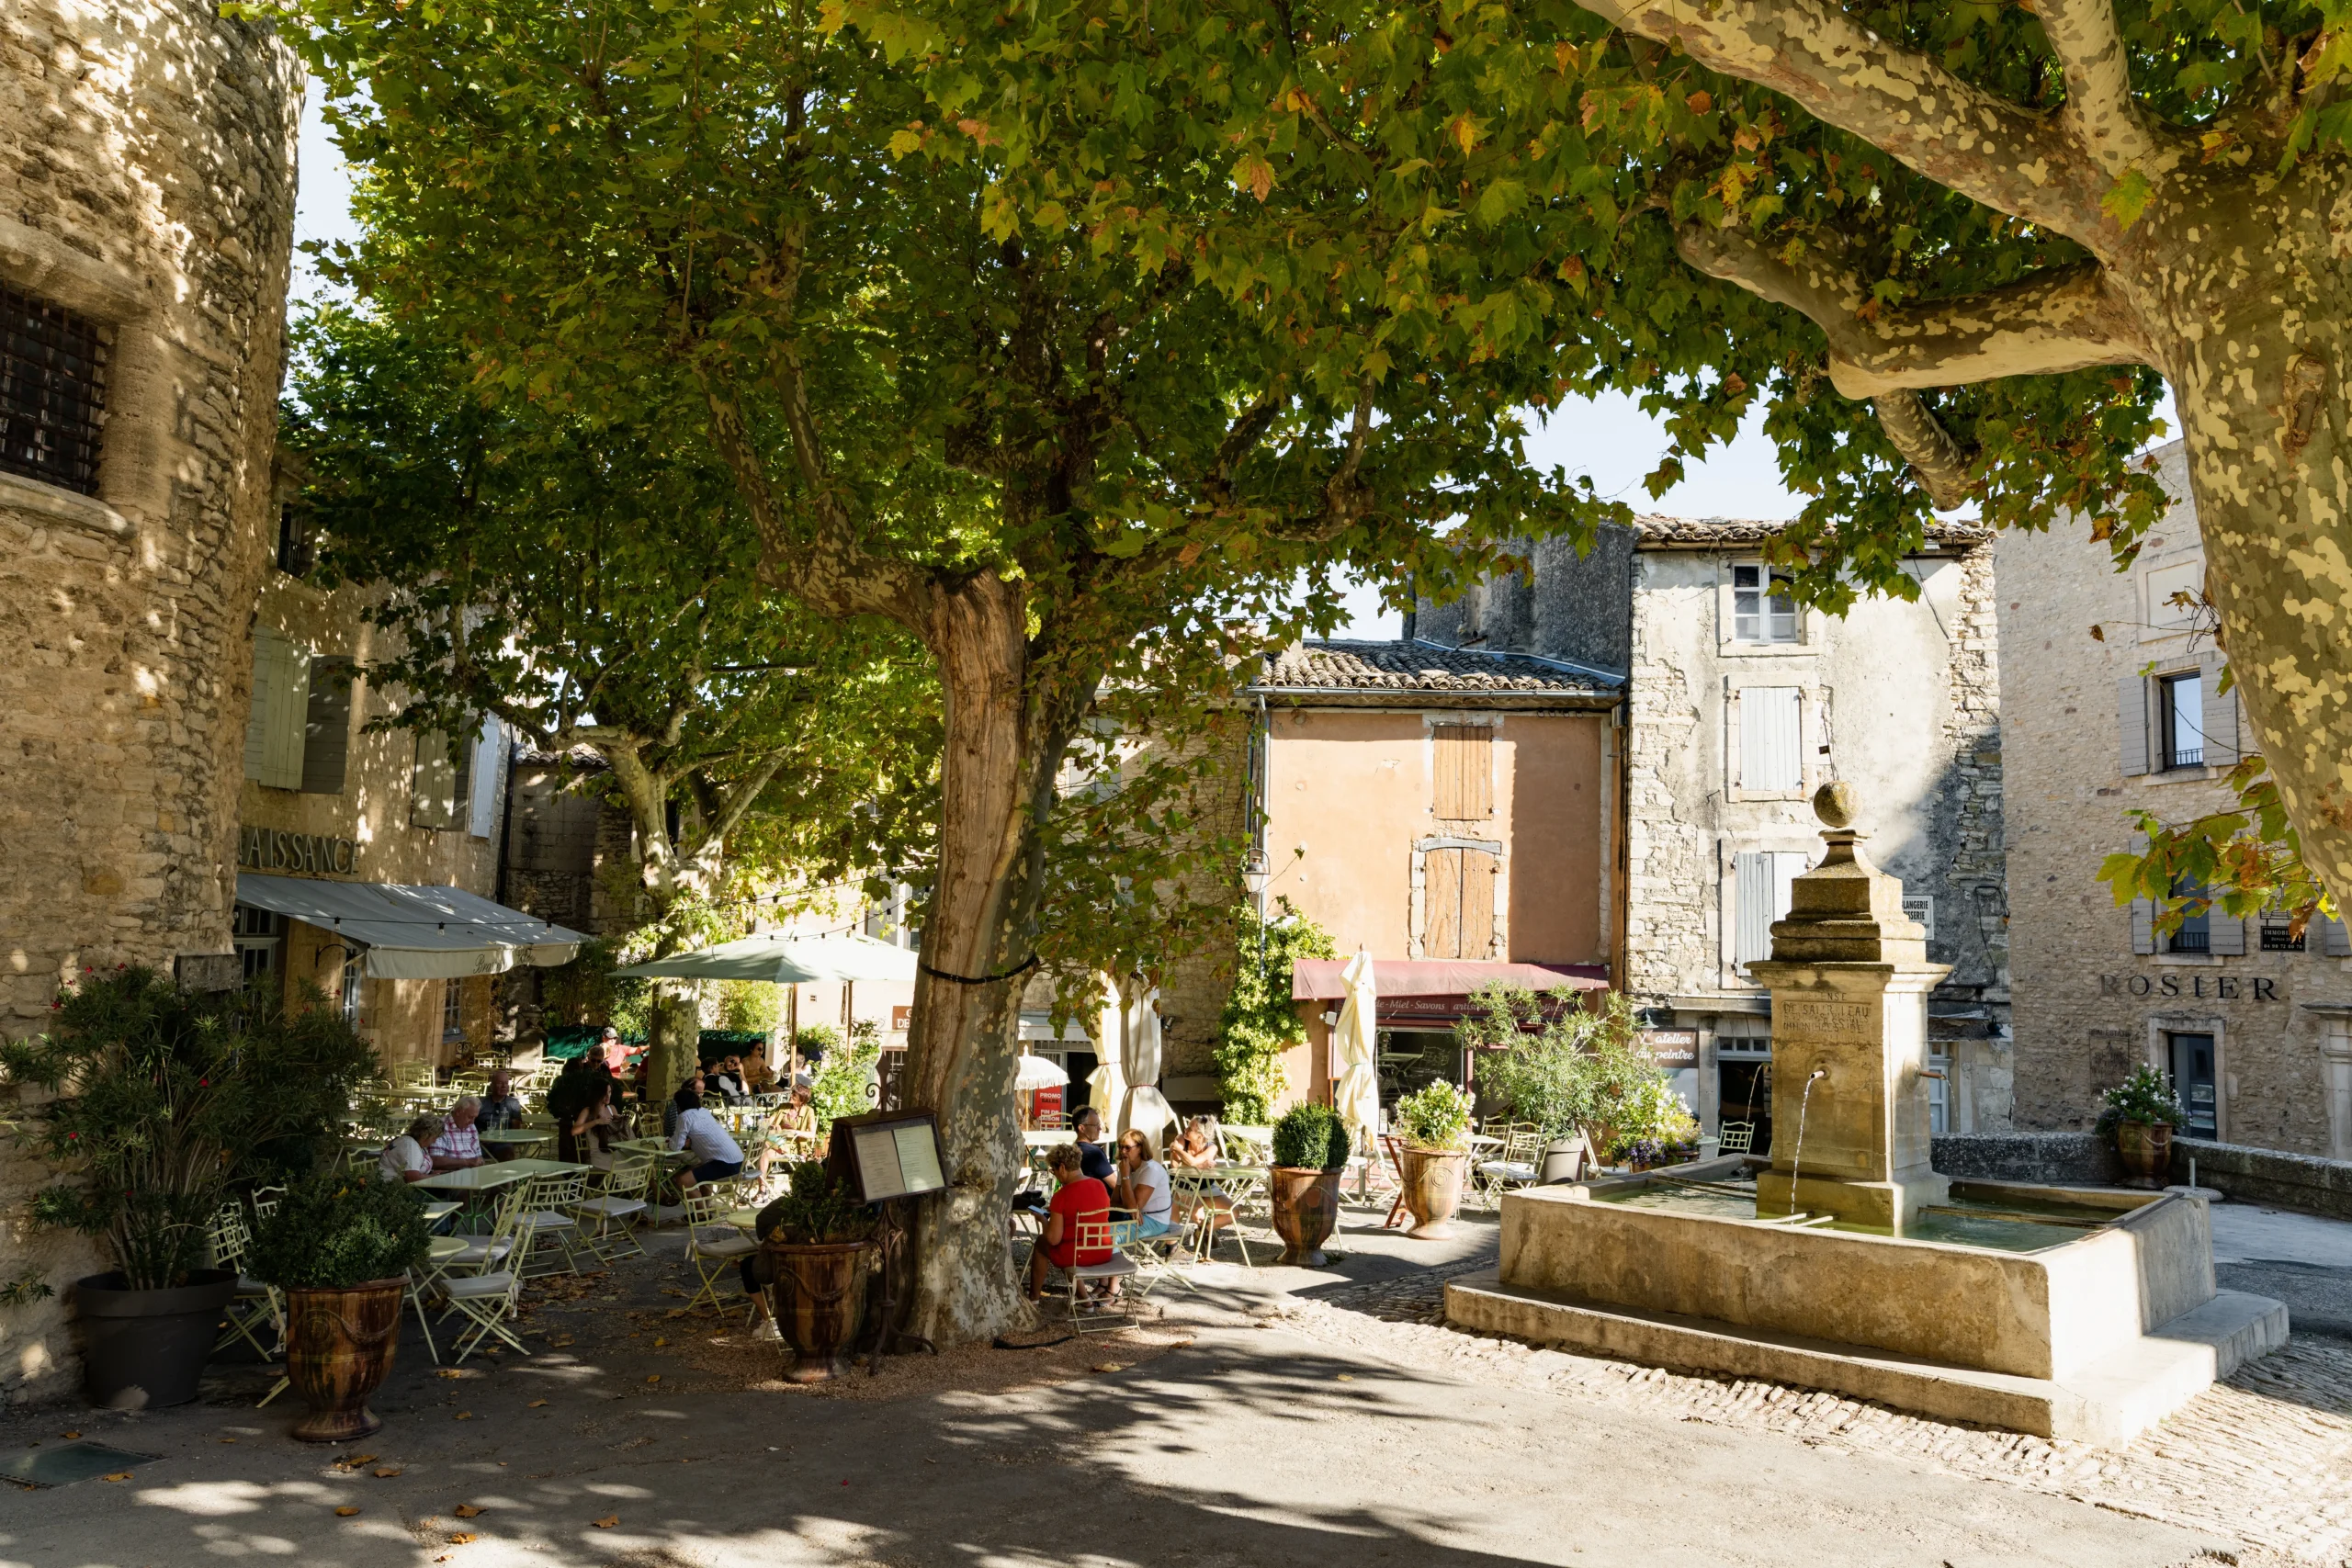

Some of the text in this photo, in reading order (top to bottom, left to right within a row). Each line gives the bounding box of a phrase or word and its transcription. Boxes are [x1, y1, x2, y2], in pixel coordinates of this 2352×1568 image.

[1902, 901, 1928, 909] LANGERIE
[2100, 974, 2279, 1000] ROSIER
[1389, 999, 1410, 1010] Miel
[1414, 999, 1445, 1010] Savons
[1654, 1047, 1695, 1063] peintre
